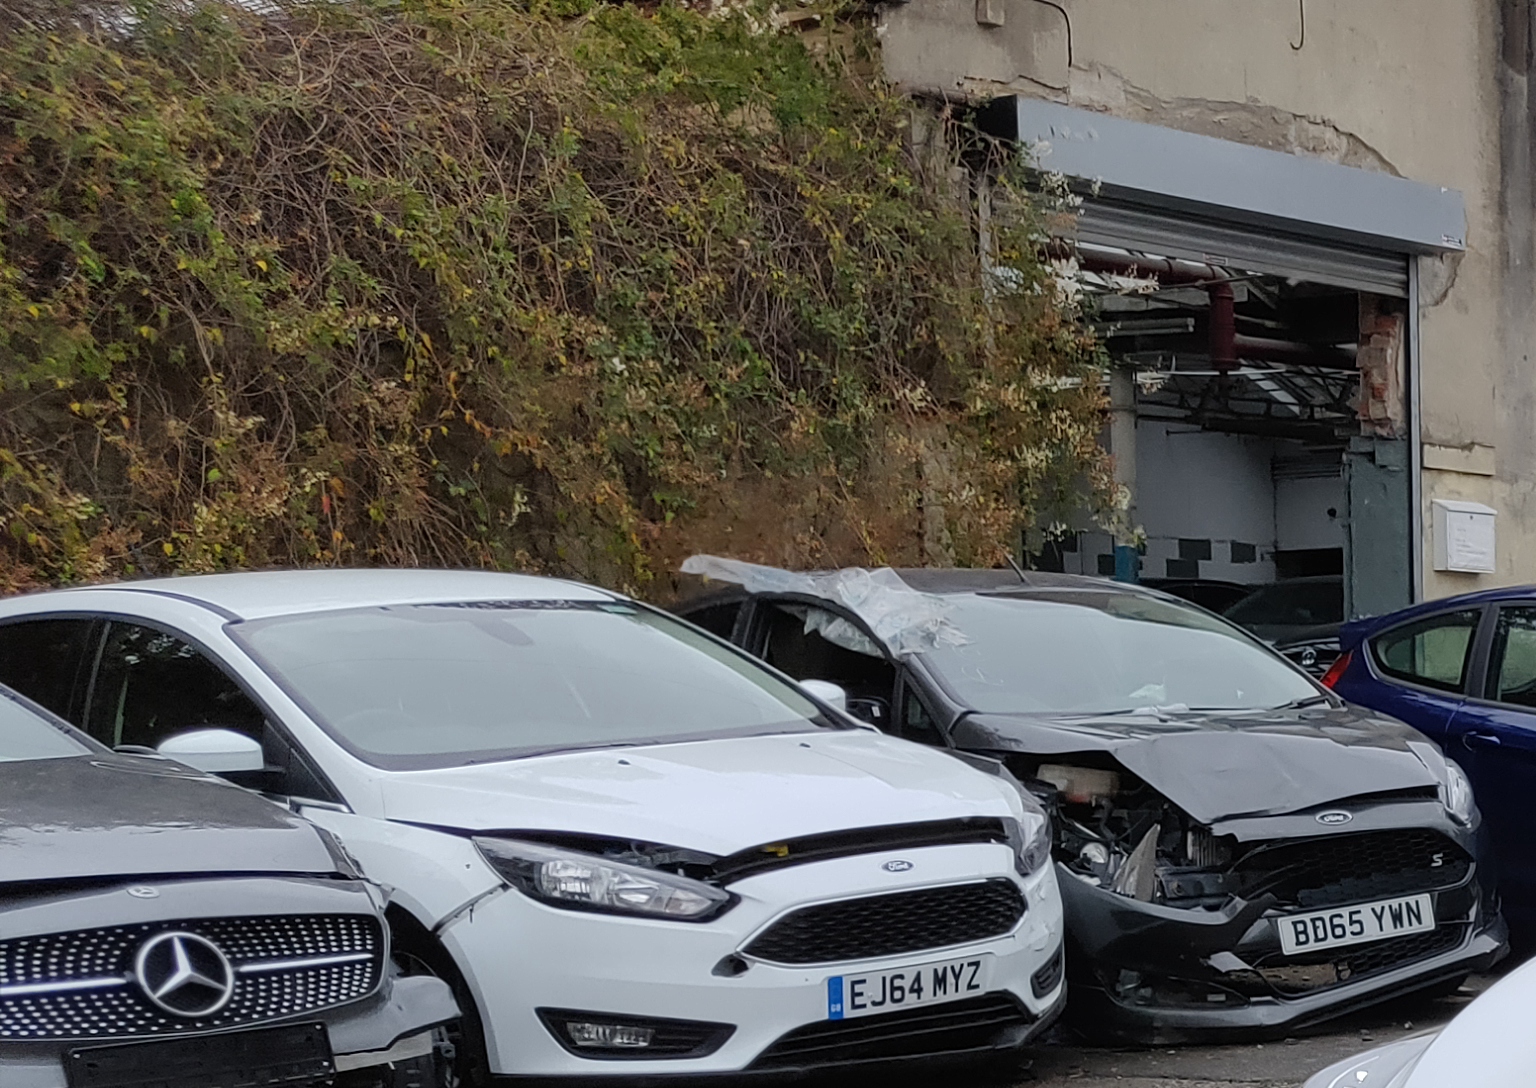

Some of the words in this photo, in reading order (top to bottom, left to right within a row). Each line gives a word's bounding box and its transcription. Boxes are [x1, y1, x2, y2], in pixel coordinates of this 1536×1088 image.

[1430, 853, 1443, 867] S
[1291, 910, 1365, 947] BD65
[1371, 899, 1423, 932] YWN
[850, 970, 924, 1010] EJ64
[932, 960, 982, 996] MYZ
